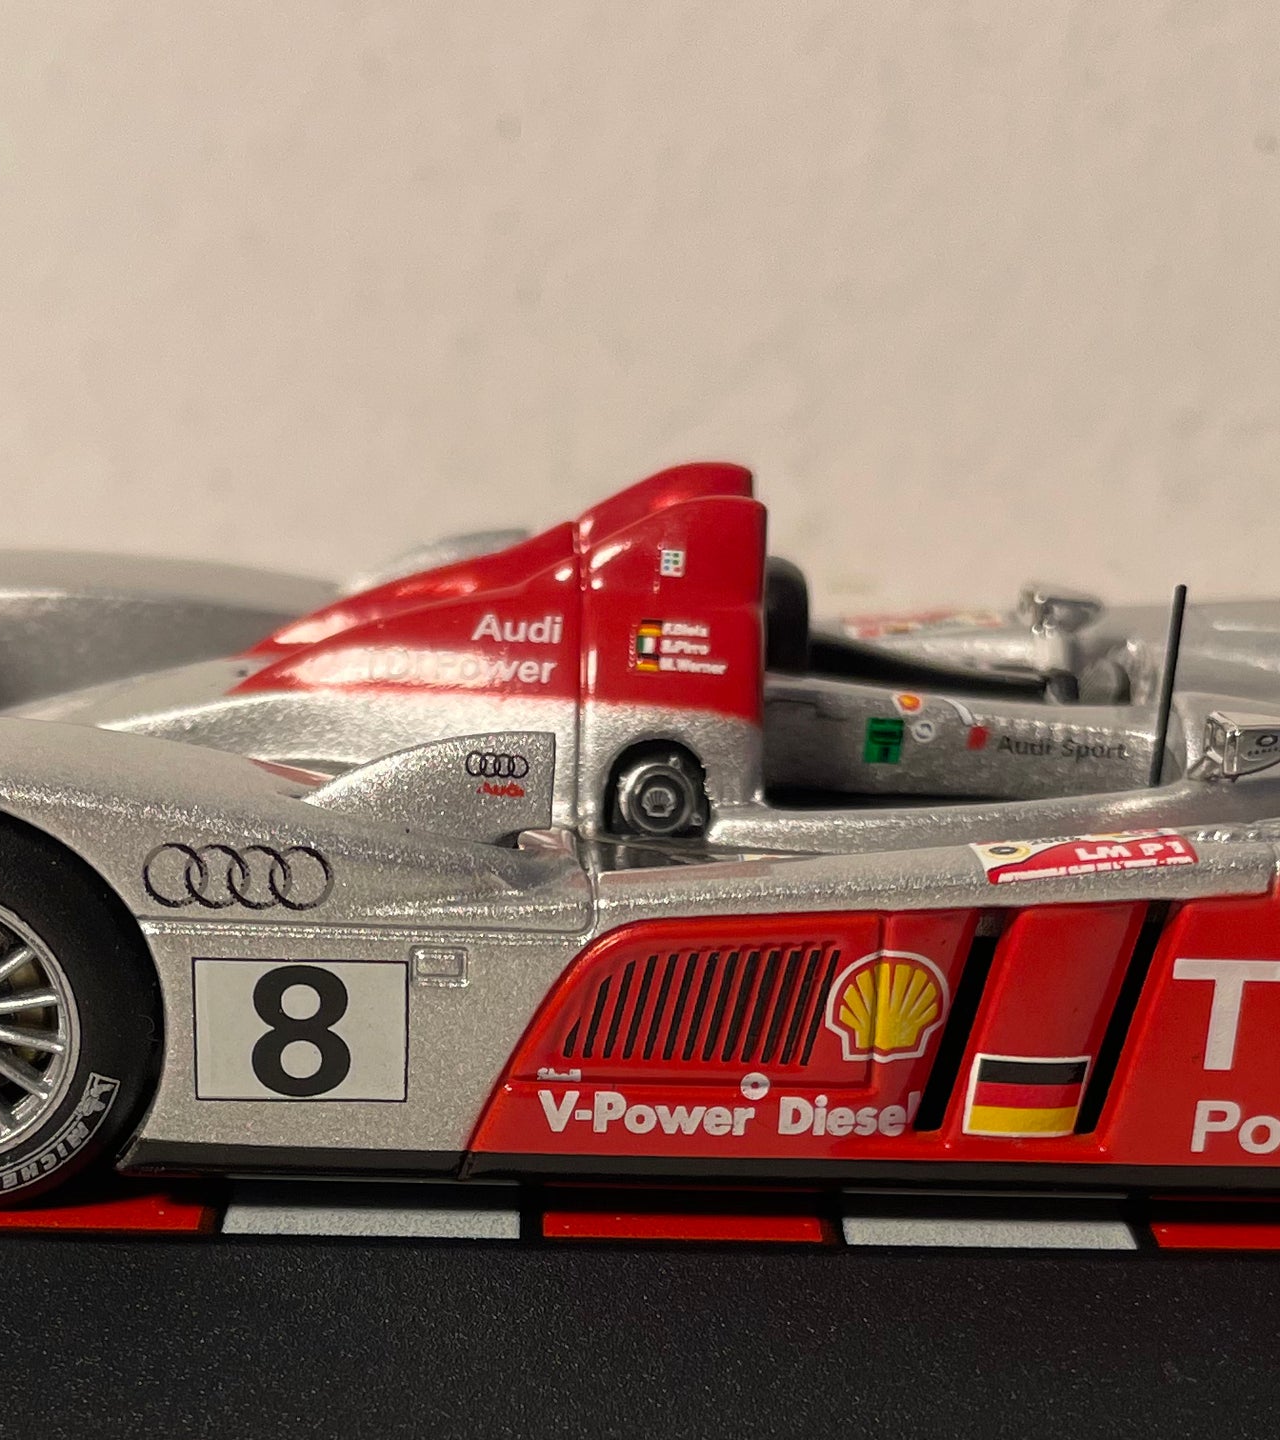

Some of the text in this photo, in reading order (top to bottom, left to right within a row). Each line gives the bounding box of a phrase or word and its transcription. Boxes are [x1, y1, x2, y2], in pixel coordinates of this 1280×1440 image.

[470, 613, 564, 644] Audi
[434, 652, 559, 684] Power
[998, 734, 1129, 763] Audi Sport
[1075, 840, 1187, 862] LM P1
[251, 964, 352, 1098] 8
[537, 1089, 756, 1137] V-Power
